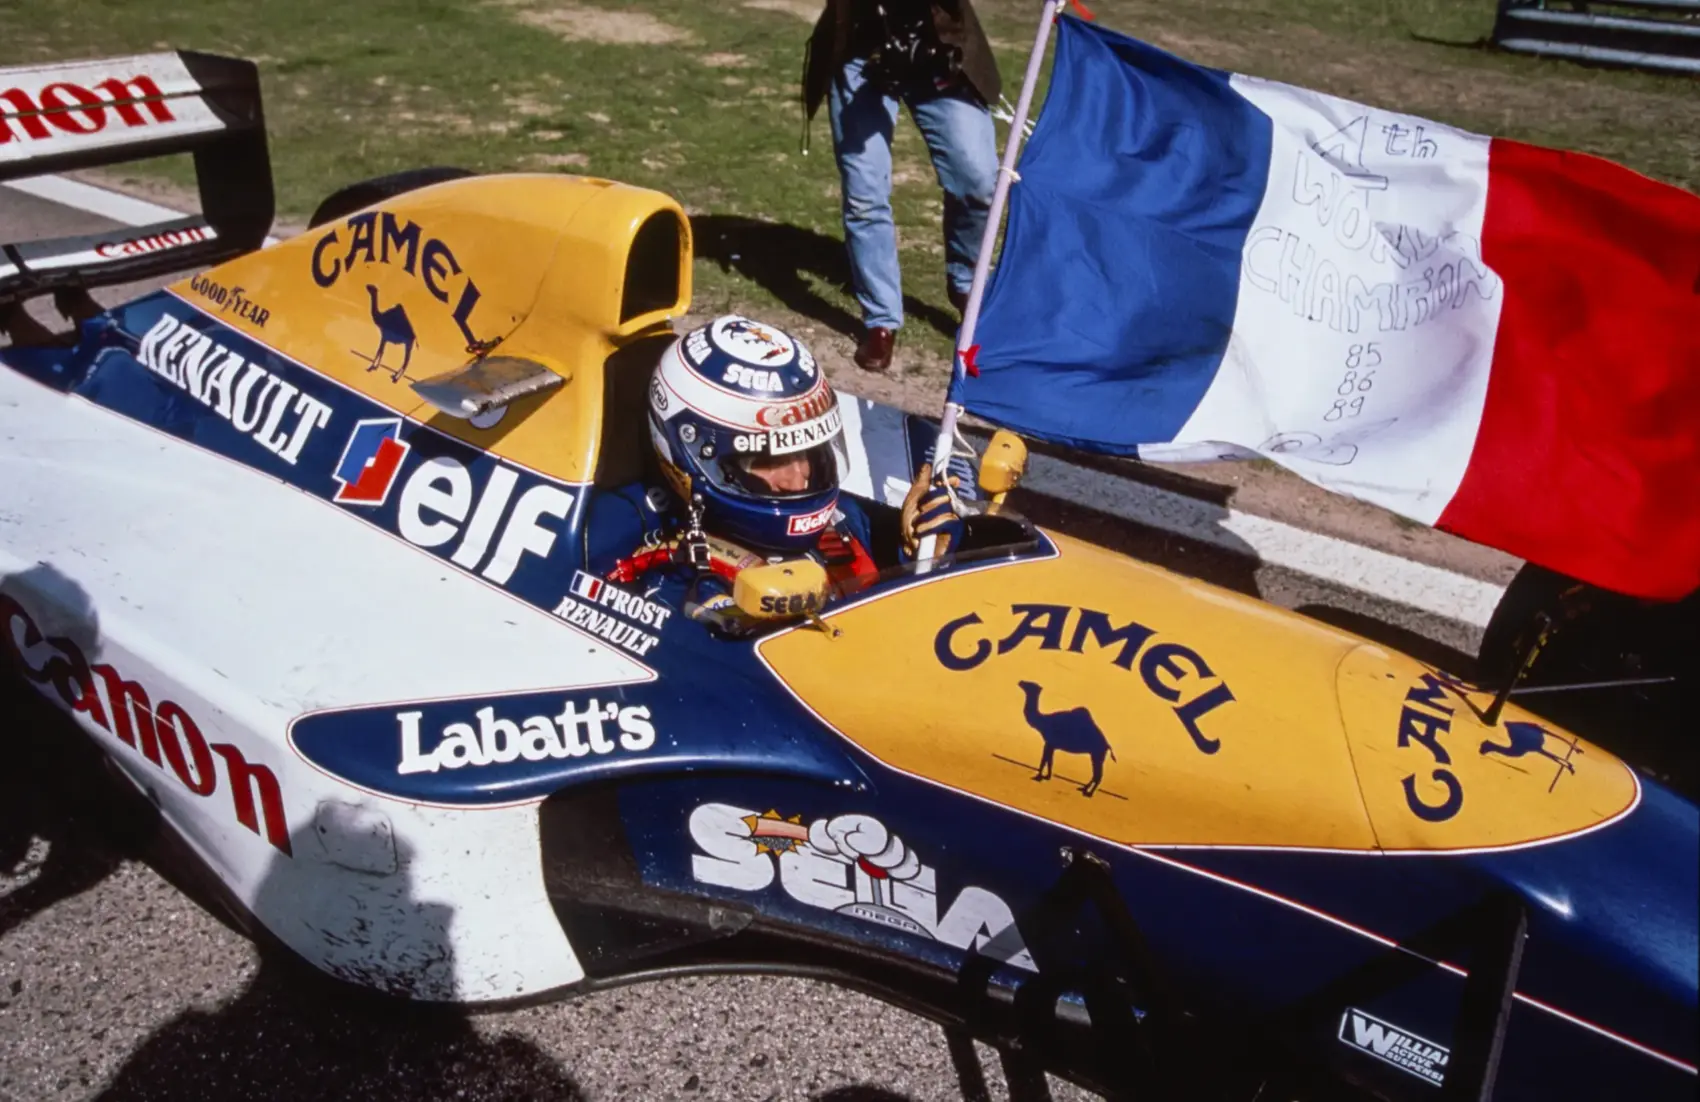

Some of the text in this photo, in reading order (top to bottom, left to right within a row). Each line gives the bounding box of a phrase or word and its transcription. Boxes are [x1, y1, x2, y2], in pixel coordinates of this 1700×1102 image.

[0, 75, 176, 143] non
[1311, 114, 1438, 207] 4th
[96, 226, 207, 257] Canon
[311, 211, 485, 354] CAMEL
[723, 363, 784, 392] SEGA
[1337, 370, 1373, 396] 86
[1345, 342, 1382, 368] 85
[136, 312, 333, 465] RENAULT
[1324, 396, 1365, 421] 89
[733, 434, 769, 452] elf
[398, 456, 575, 585] elf
[553, 594, 658, 656] RENAULT
[600, 585, 671, 630] PROST
[932, 603, 1236, 755] CAMEL
[2, 599, 293, 859] Canon
[396, 698, 656, 775] Labatt's
[1397, 670, 1466, 822] CAM
[689, 803, 1040, 973] SEGA
[1352, 1014, 1449, 1066] WILLIA
[1385, 1051, 1444, 1081] SUSPENSI
[1390, 1045, 1434, 1069] ACTIVE
